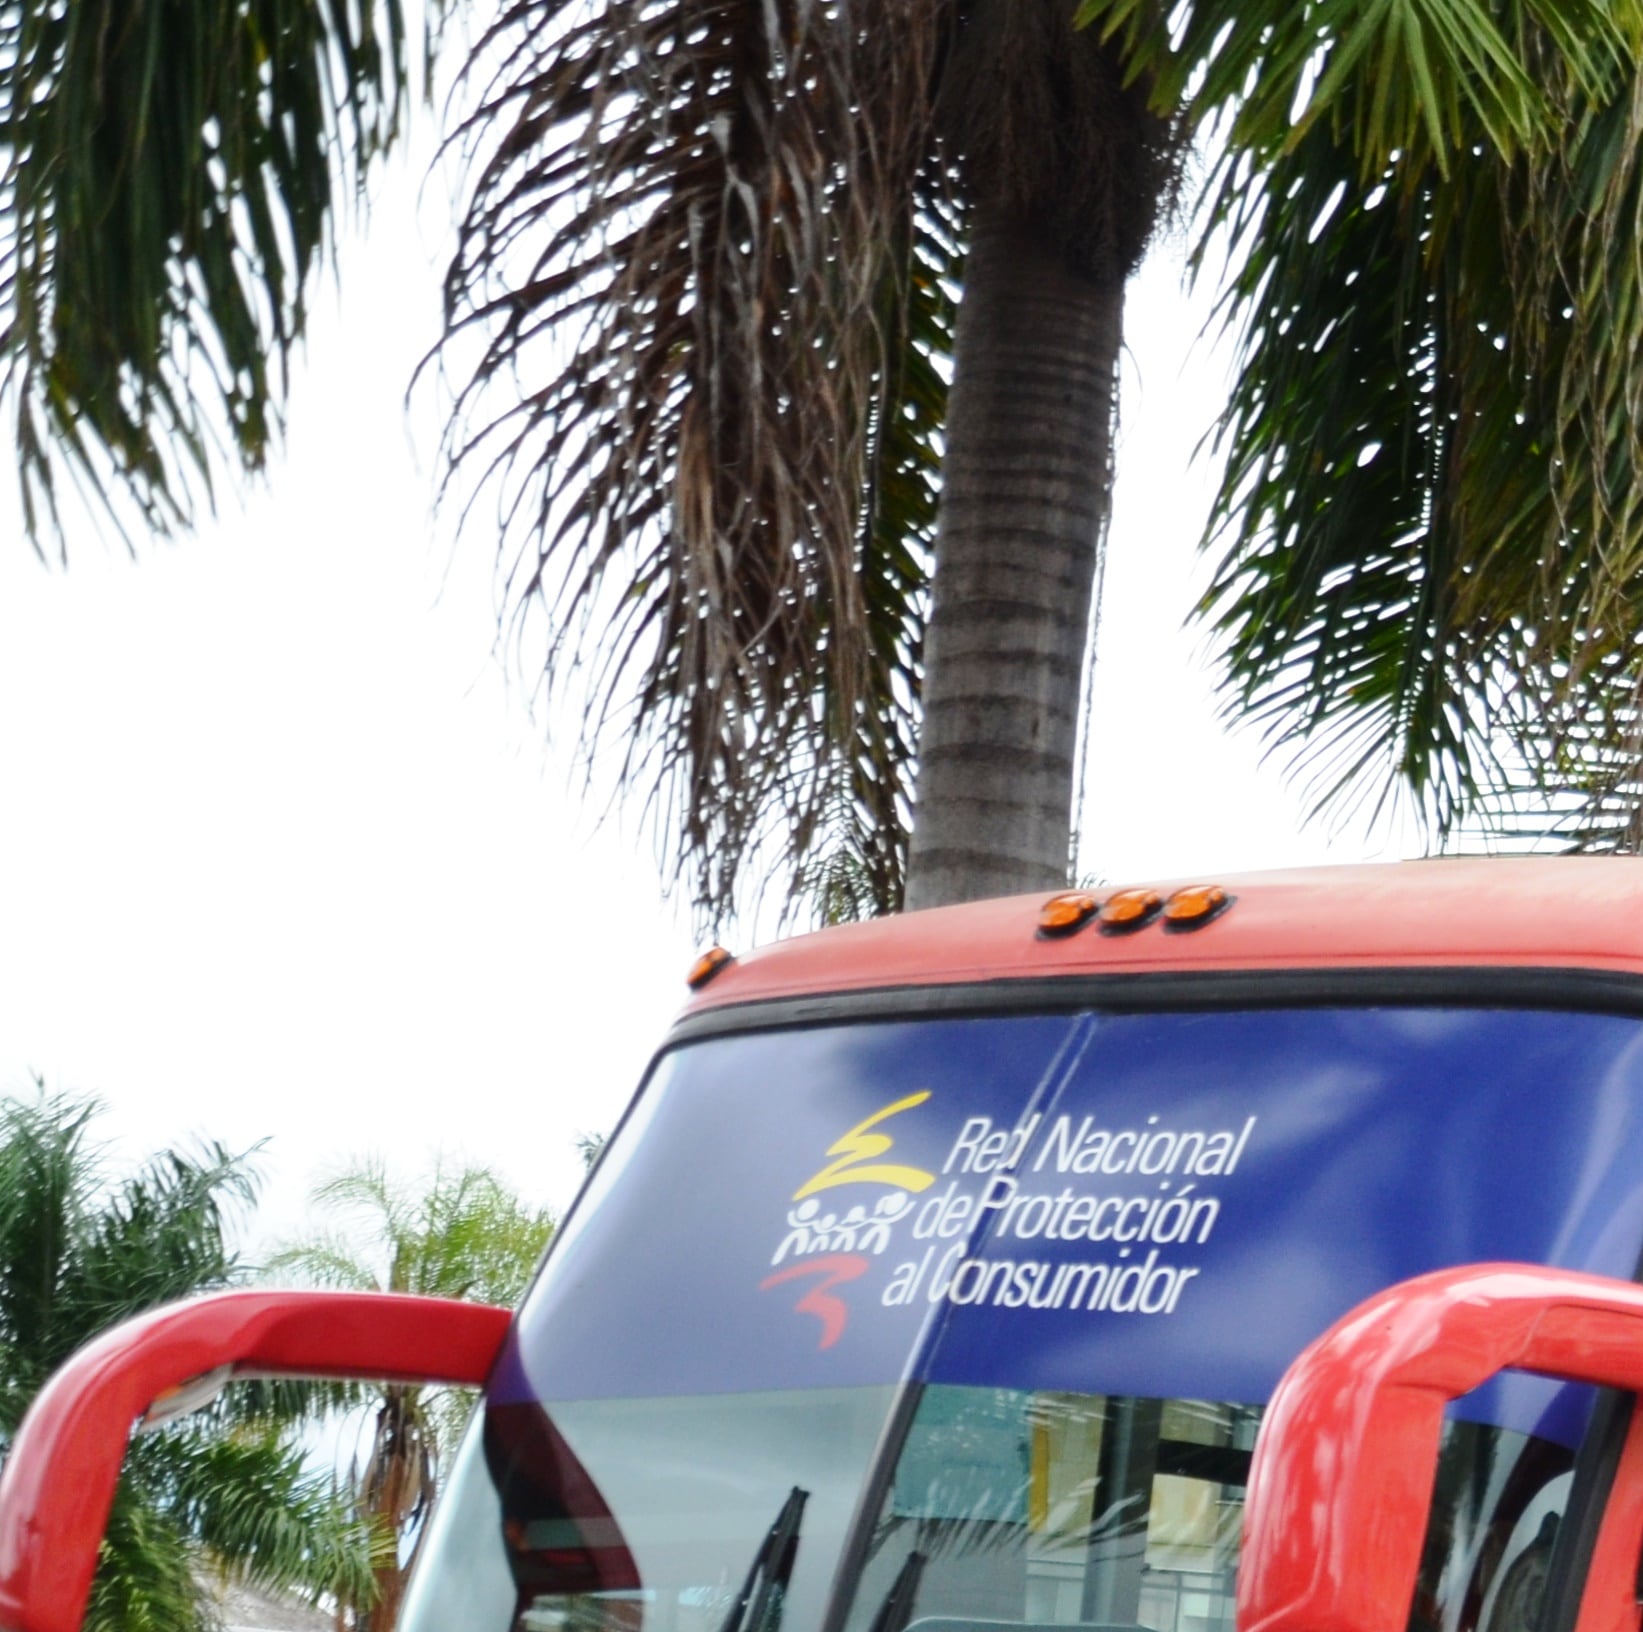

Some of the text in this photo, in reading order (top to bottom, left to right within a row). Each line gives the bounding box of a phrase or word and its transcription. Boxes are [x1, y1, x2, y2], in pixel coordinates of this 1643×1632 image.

[941, 1113, 1258, 1177] Red Nacional
[911, 1174, 1222, 1245] de Protección
[881, 1242, 1199, 1314] al Consumidor
